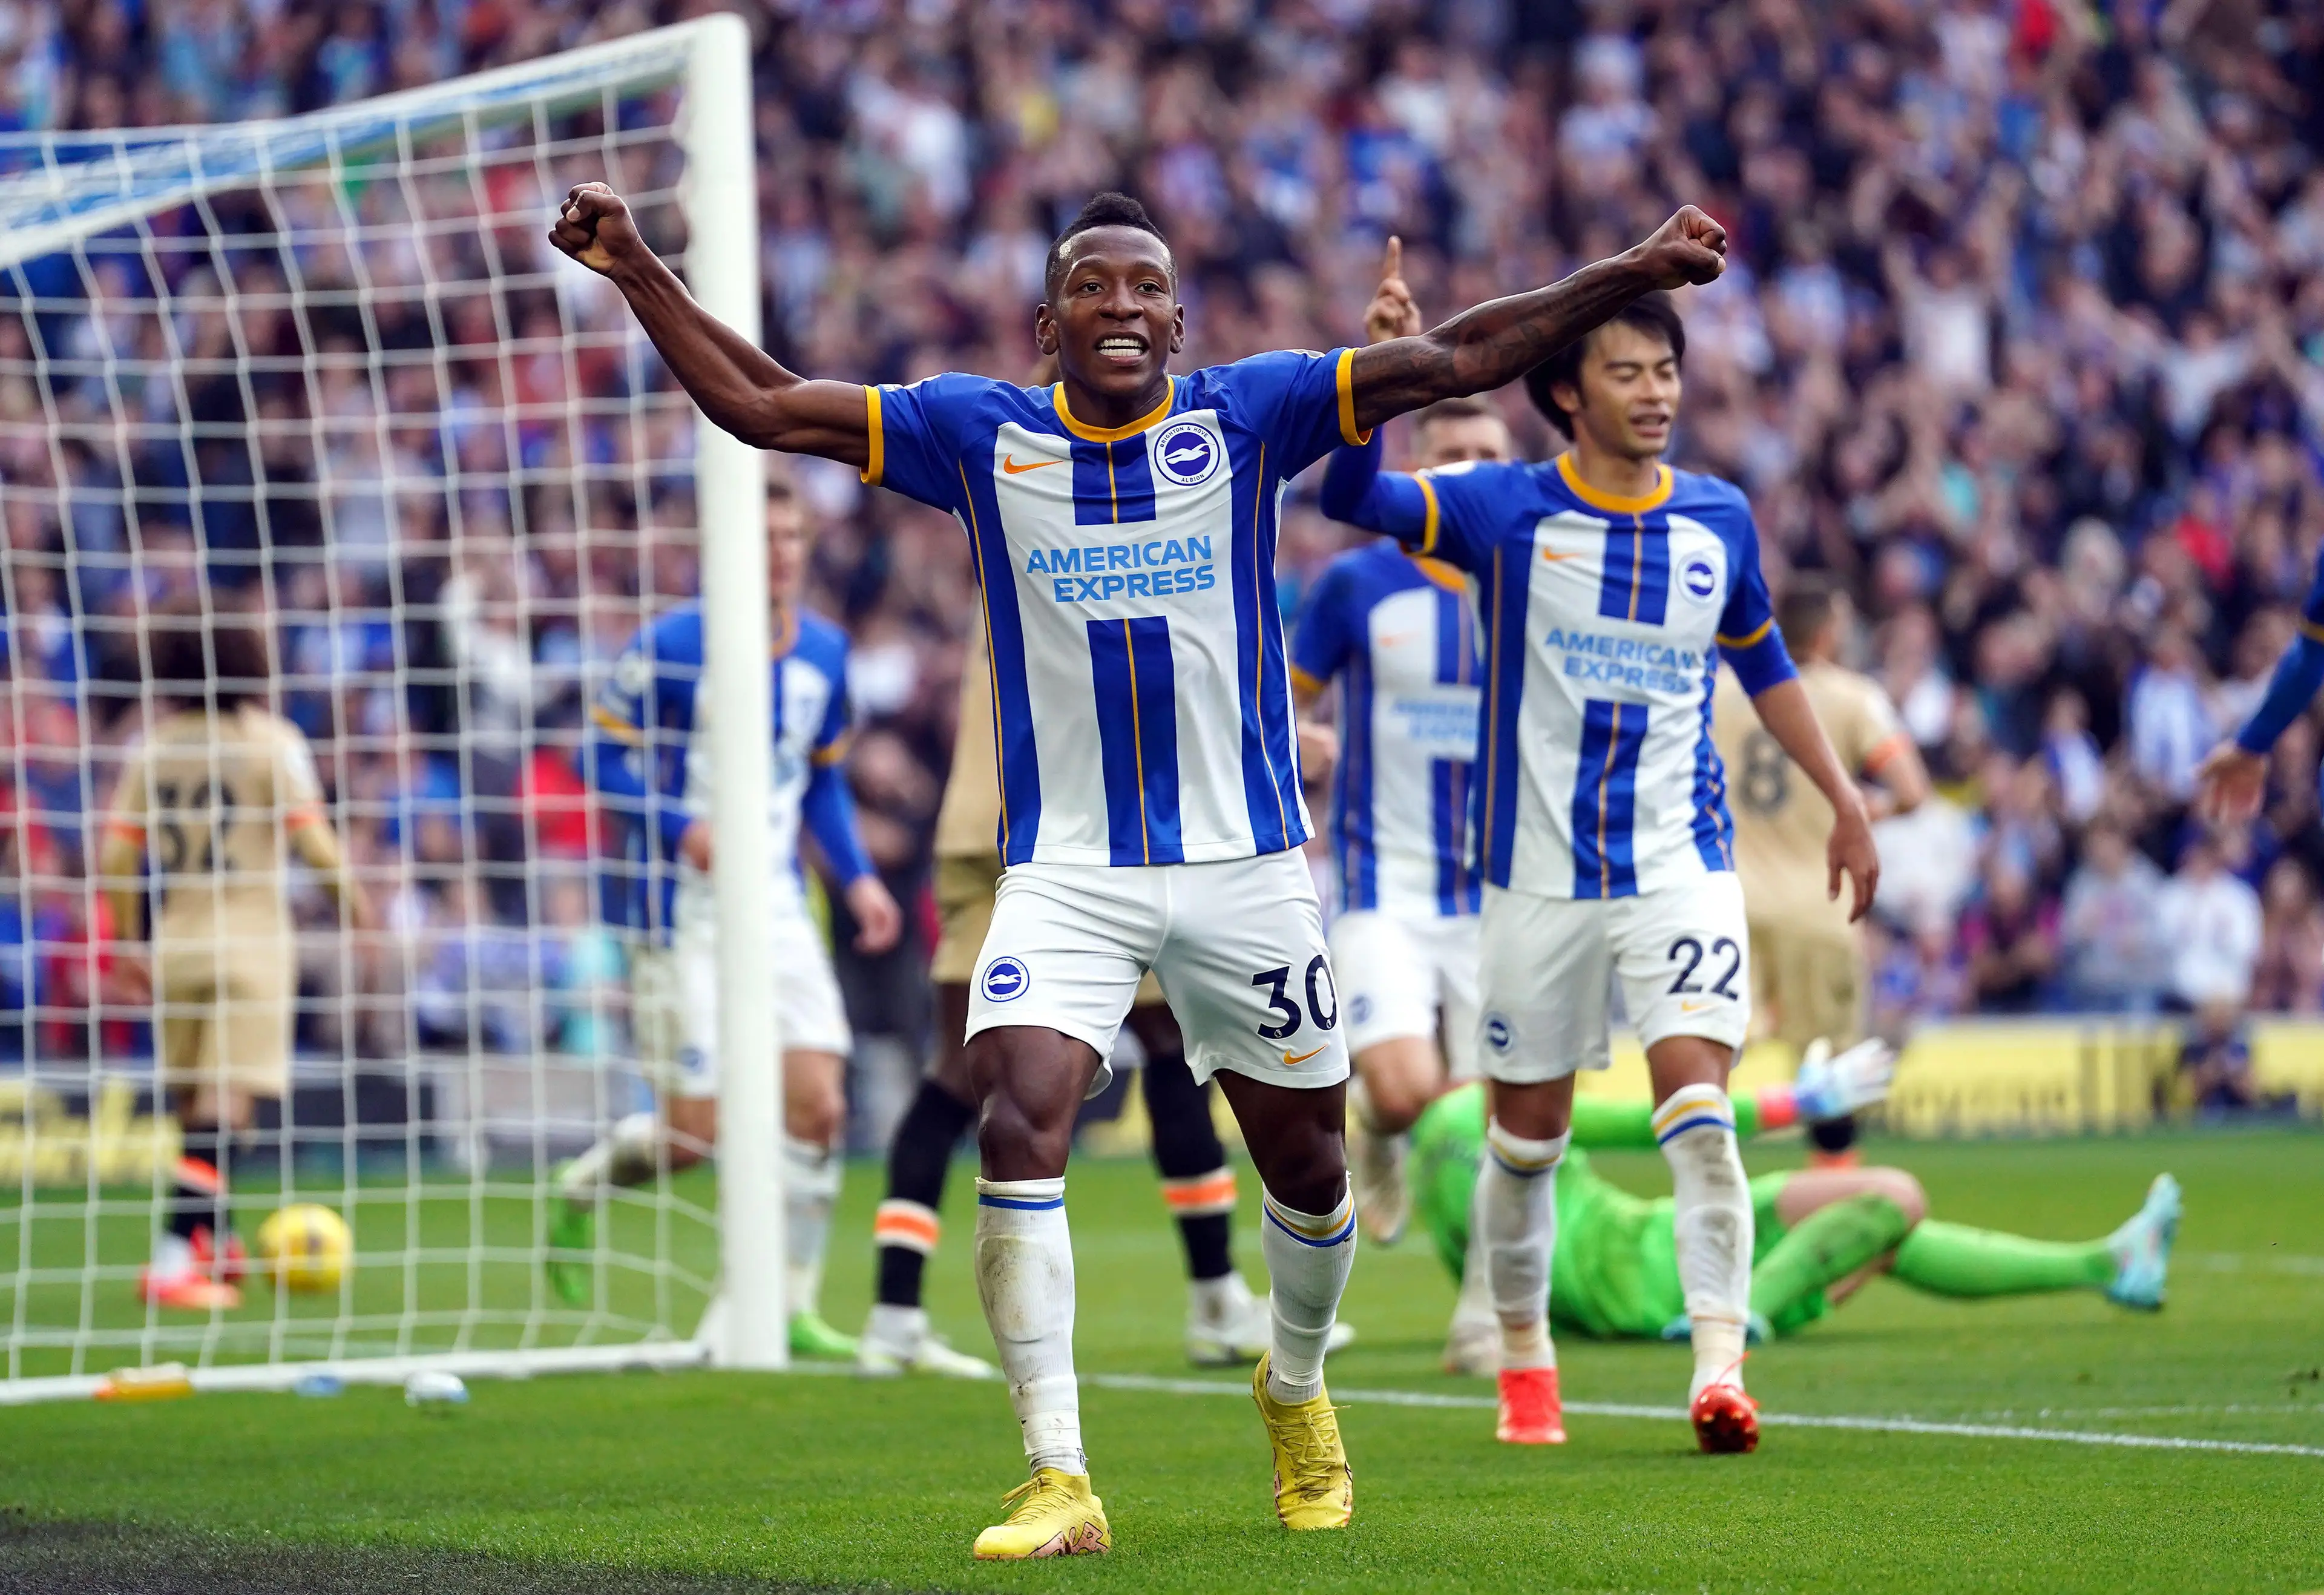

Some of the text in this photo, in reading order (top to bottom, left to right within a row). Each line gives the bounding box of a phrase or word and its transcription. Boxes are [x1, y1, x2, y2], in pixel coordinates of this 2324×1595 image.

[1160, 426, 1184, 448] BRIGHTON
[1193, 427, 1209, 438] HOVE
[1181, 473, 1204, 482] ALBION
[1026, 535, 1212, 574] AMERICAN
[1052, 564, 1215, 602] EXPRESS
[1544, 628, 1693, 668] AMERICAN
[1563, 654, 1692, 694] EXPRESS
[1739, 729, 1790, 815] 8
[1667, 937, 1741, 1001] 22
[1252, 955, 1337, 1039] 30
